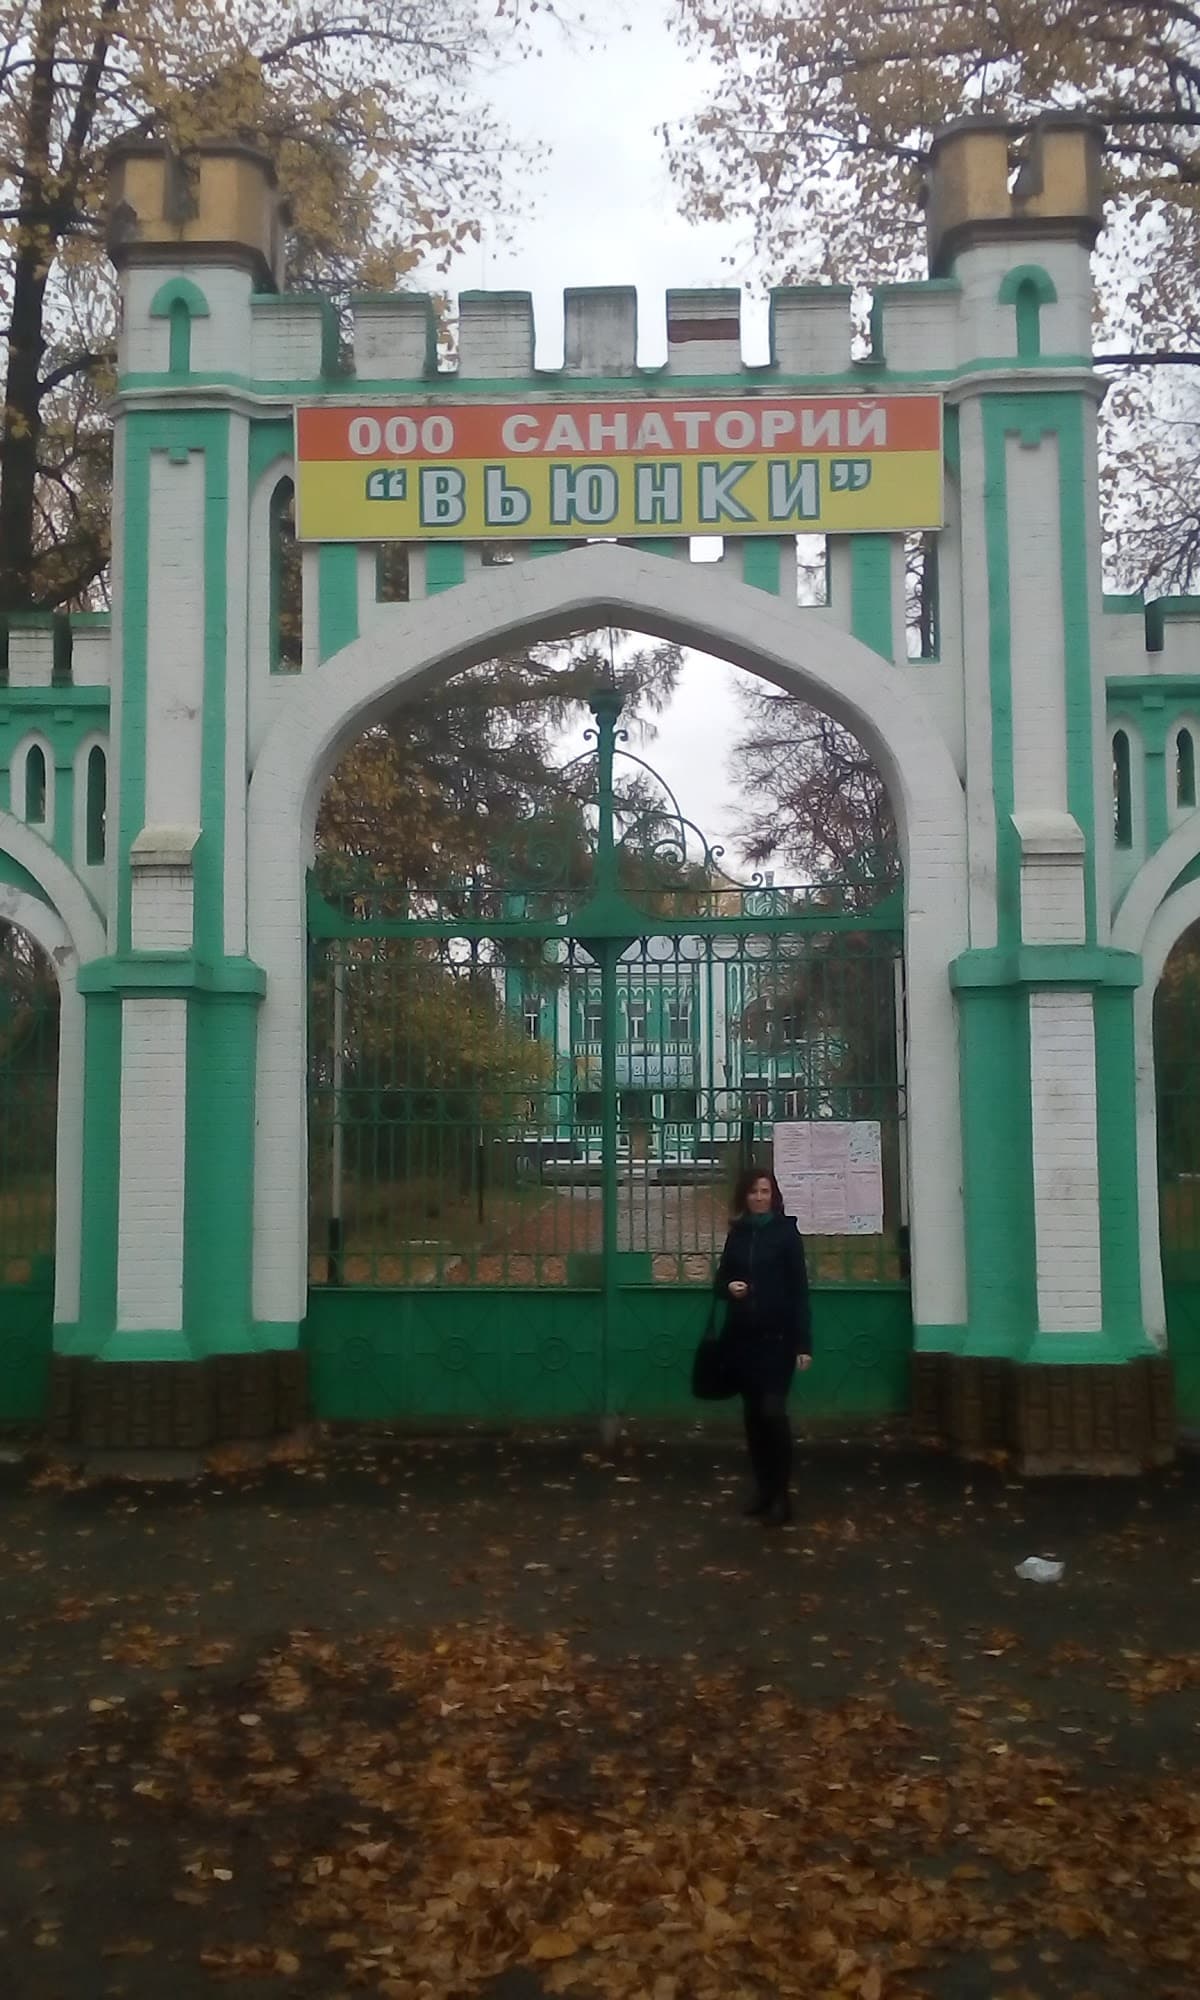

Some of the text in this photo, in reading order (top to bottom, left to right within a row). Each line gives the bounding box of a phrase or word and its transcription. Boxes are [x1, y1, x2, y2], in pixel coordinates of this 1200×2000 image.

[347, 401, 888, 455] ООО САНАТОРИЙ
[366, 460, 872, 526] “ВЬЮНКИ”
